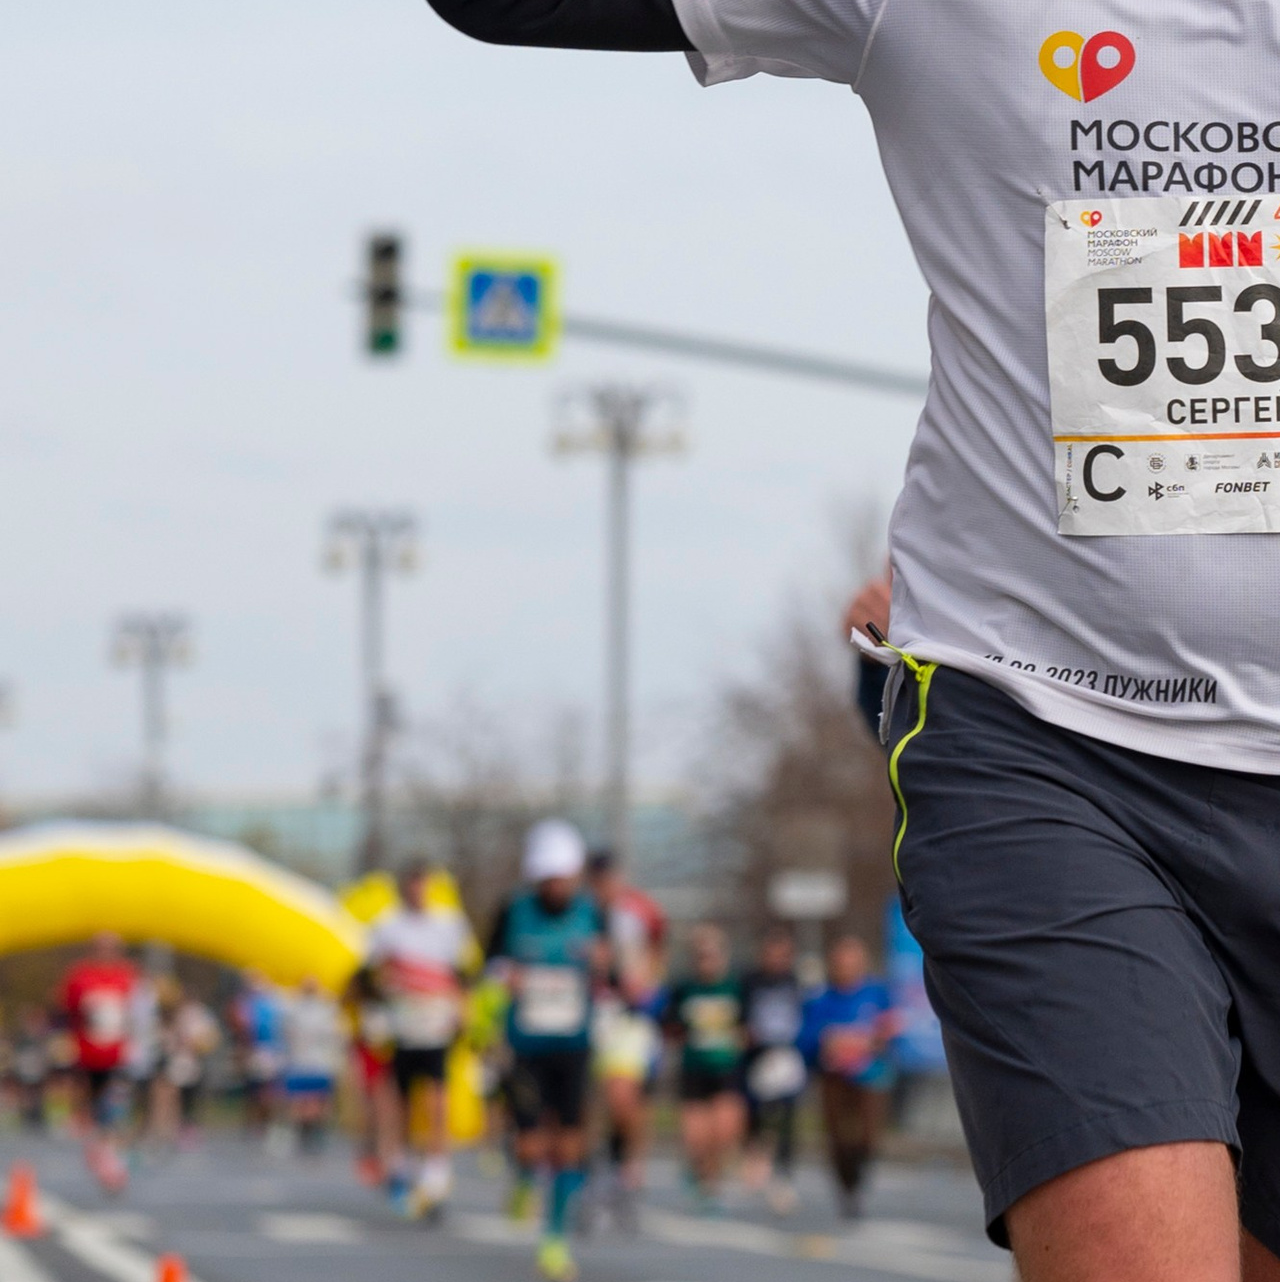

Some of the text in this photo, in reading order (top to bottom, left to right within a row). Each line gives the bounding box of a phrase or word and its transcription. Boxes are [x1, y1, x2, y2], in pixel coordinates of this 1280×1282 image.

[1087, 227, 1158, 239] МОСКОВСКИЙ
[1087, 238, 1138, 248] МАРАФОН
[1087, 248, 1132, 257] MOSCOW
[1087, 257, 1143, 267] MARATHON
[1214, 480, 1271, 494] FONBET
[1102, 673, 1218, 704] ЛУЖНИКИ
